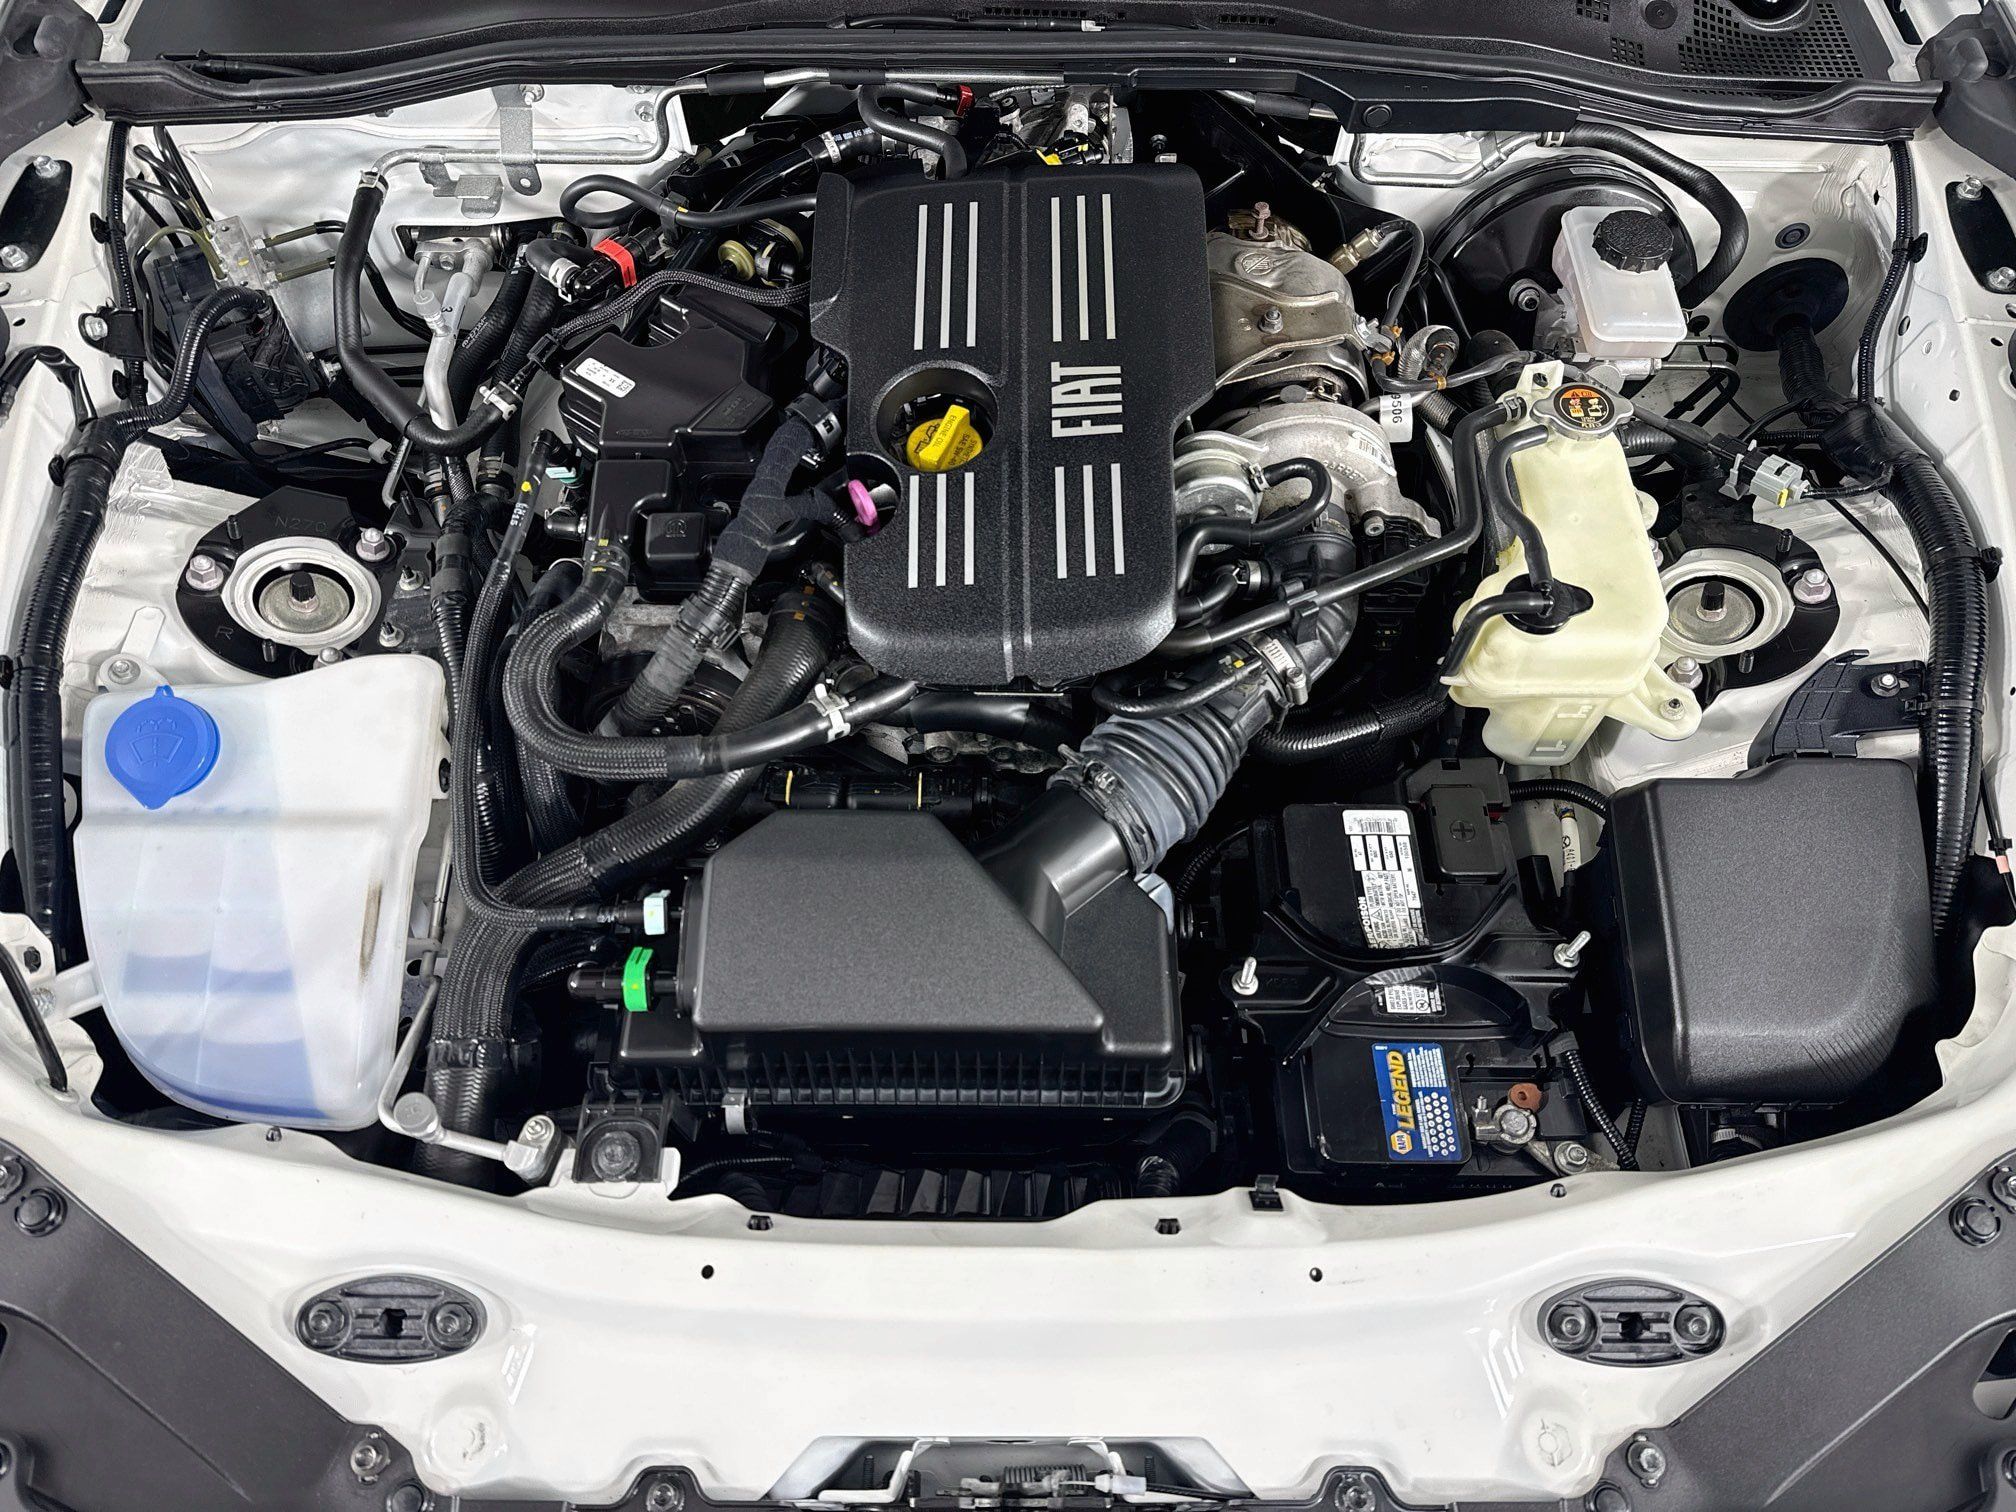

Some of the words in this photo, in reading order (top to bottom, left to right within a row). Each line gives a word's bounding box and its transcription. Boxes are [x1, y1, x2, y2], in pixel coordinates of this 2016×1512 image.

[1050, 362, 1123, 438] FIAT
[941, 414, 957, 437] ENGINE
[215, 626, 234, 640] R
[1387, 1051, 1415, 1130] LEGEND
[1396, 1134, 1407, 1150] NAPA
